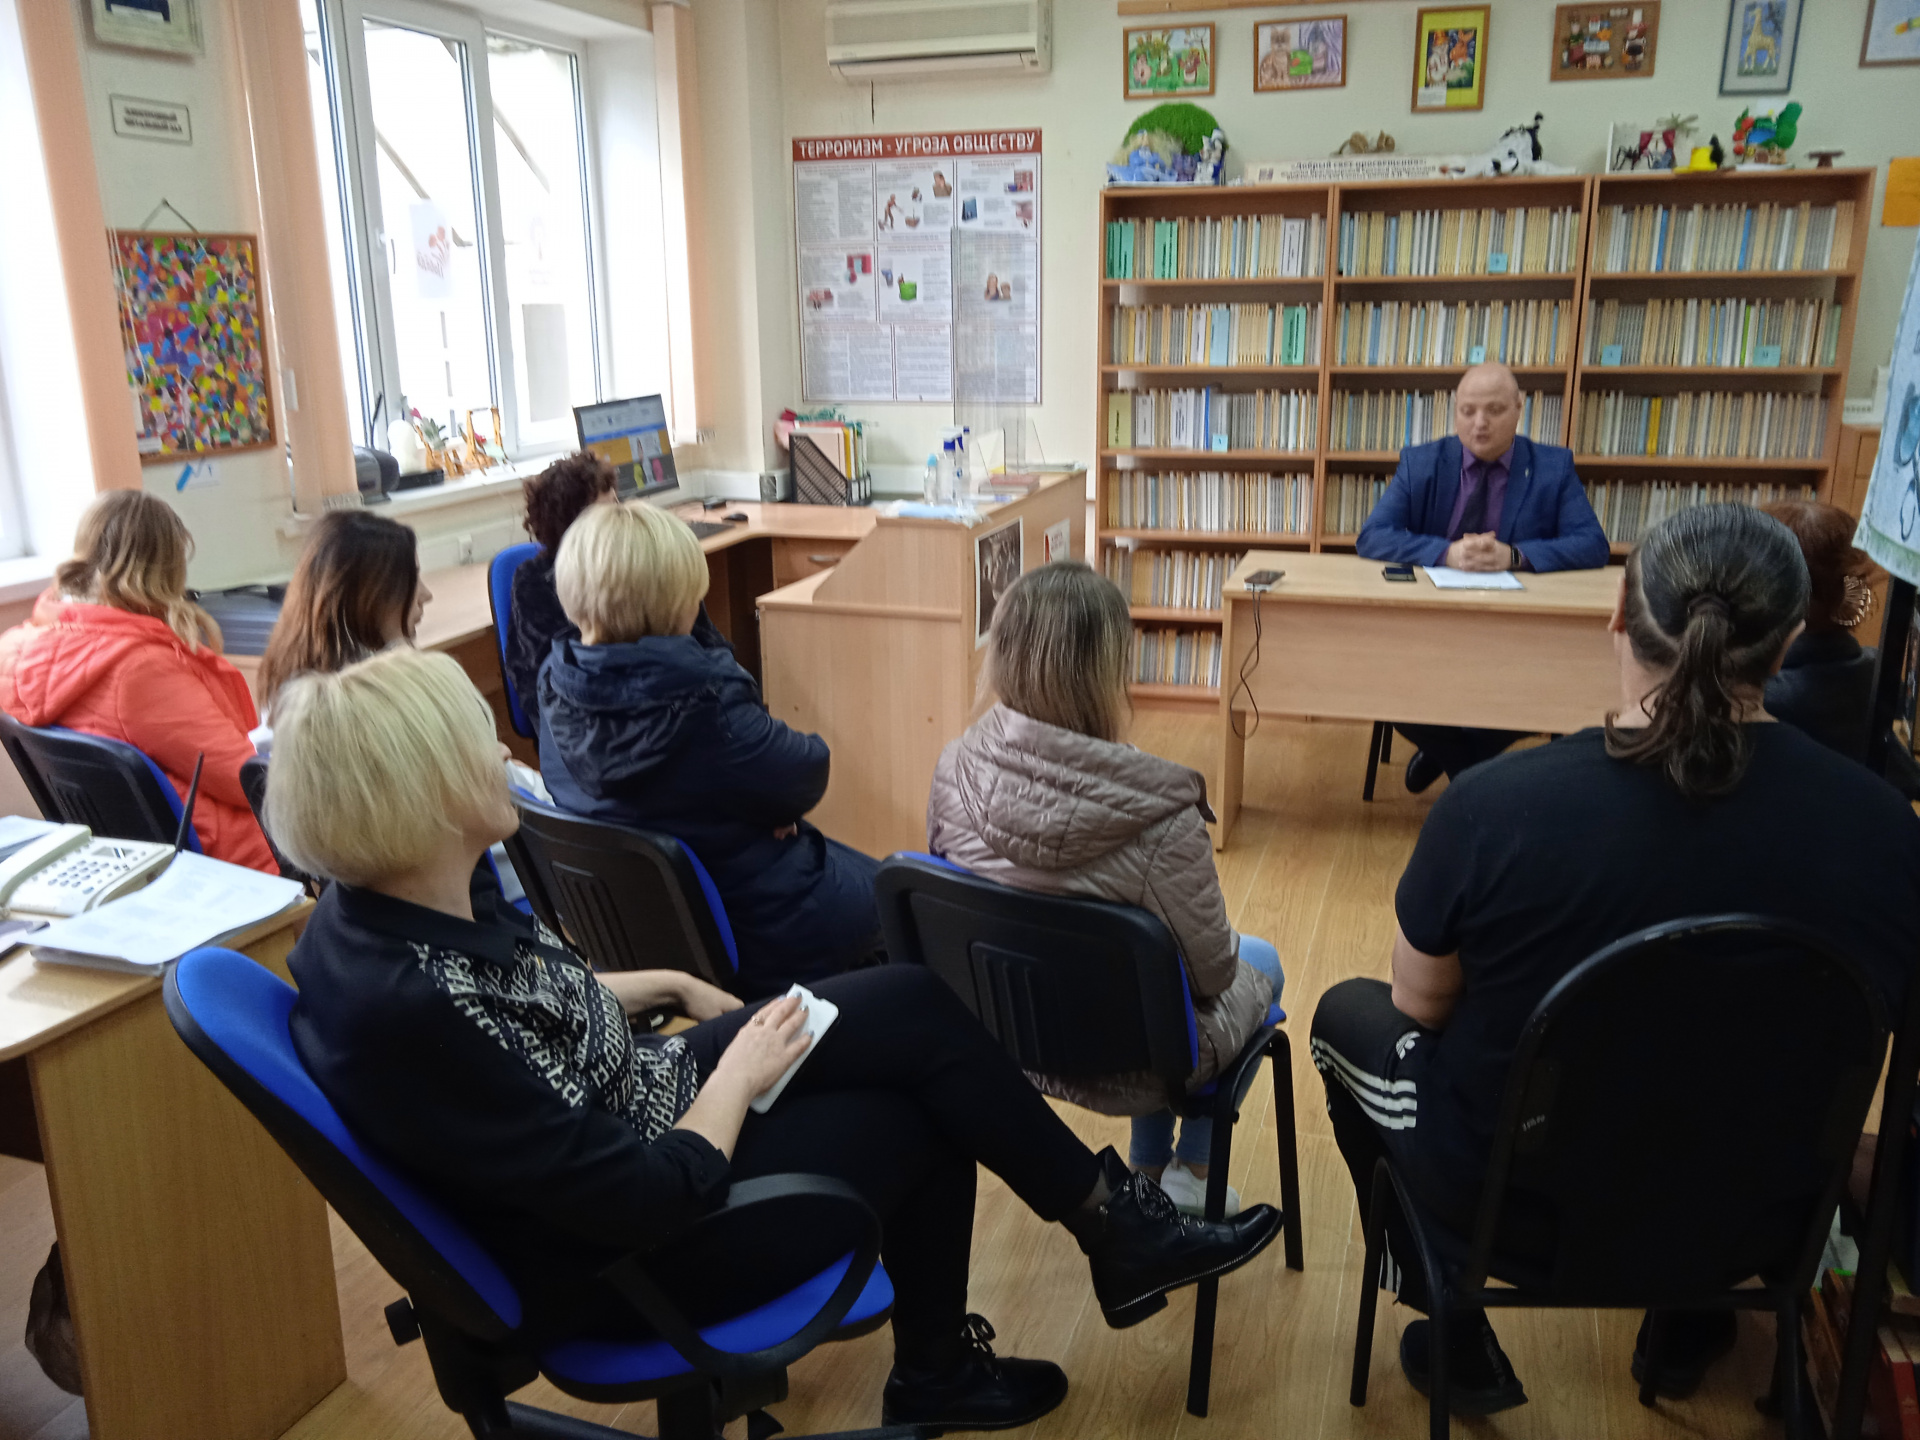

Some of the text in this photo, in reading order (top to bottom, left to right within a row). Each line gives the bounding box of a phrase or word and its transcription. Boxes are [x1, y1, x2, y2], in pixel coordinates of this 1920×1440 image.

[799, 138, 883, 159] ТЕРРОРИЗМ
[895, 135, 949, 156] УГРОЗА
[953, 132, 1036, 154] ОБЩЕСТВУ
